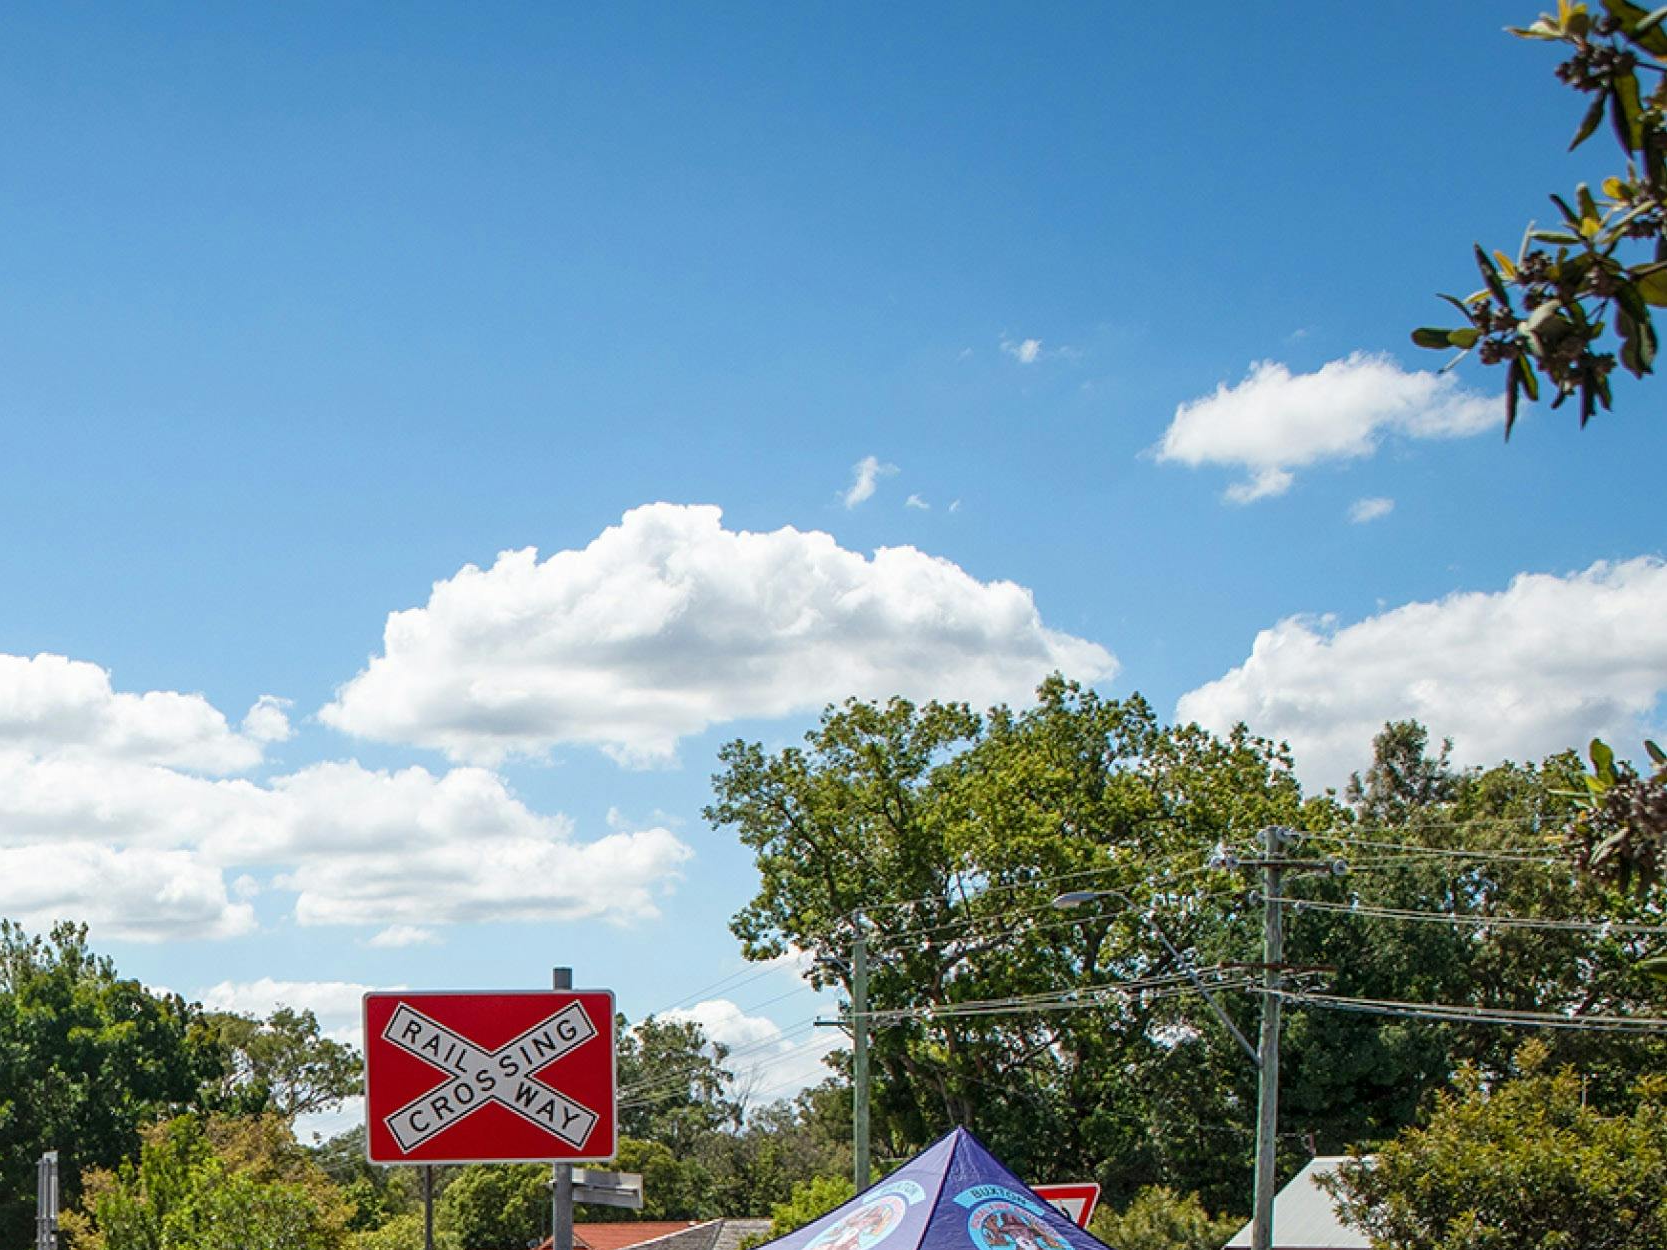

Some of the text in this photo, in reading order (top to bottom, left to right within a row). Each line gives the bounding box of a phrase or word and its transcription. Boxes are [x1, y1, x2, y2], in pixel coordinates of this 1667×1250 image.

[402, 1019, 580, 1130] RAIL WAY
[409, 1019, 577, 1132] CROSSING
